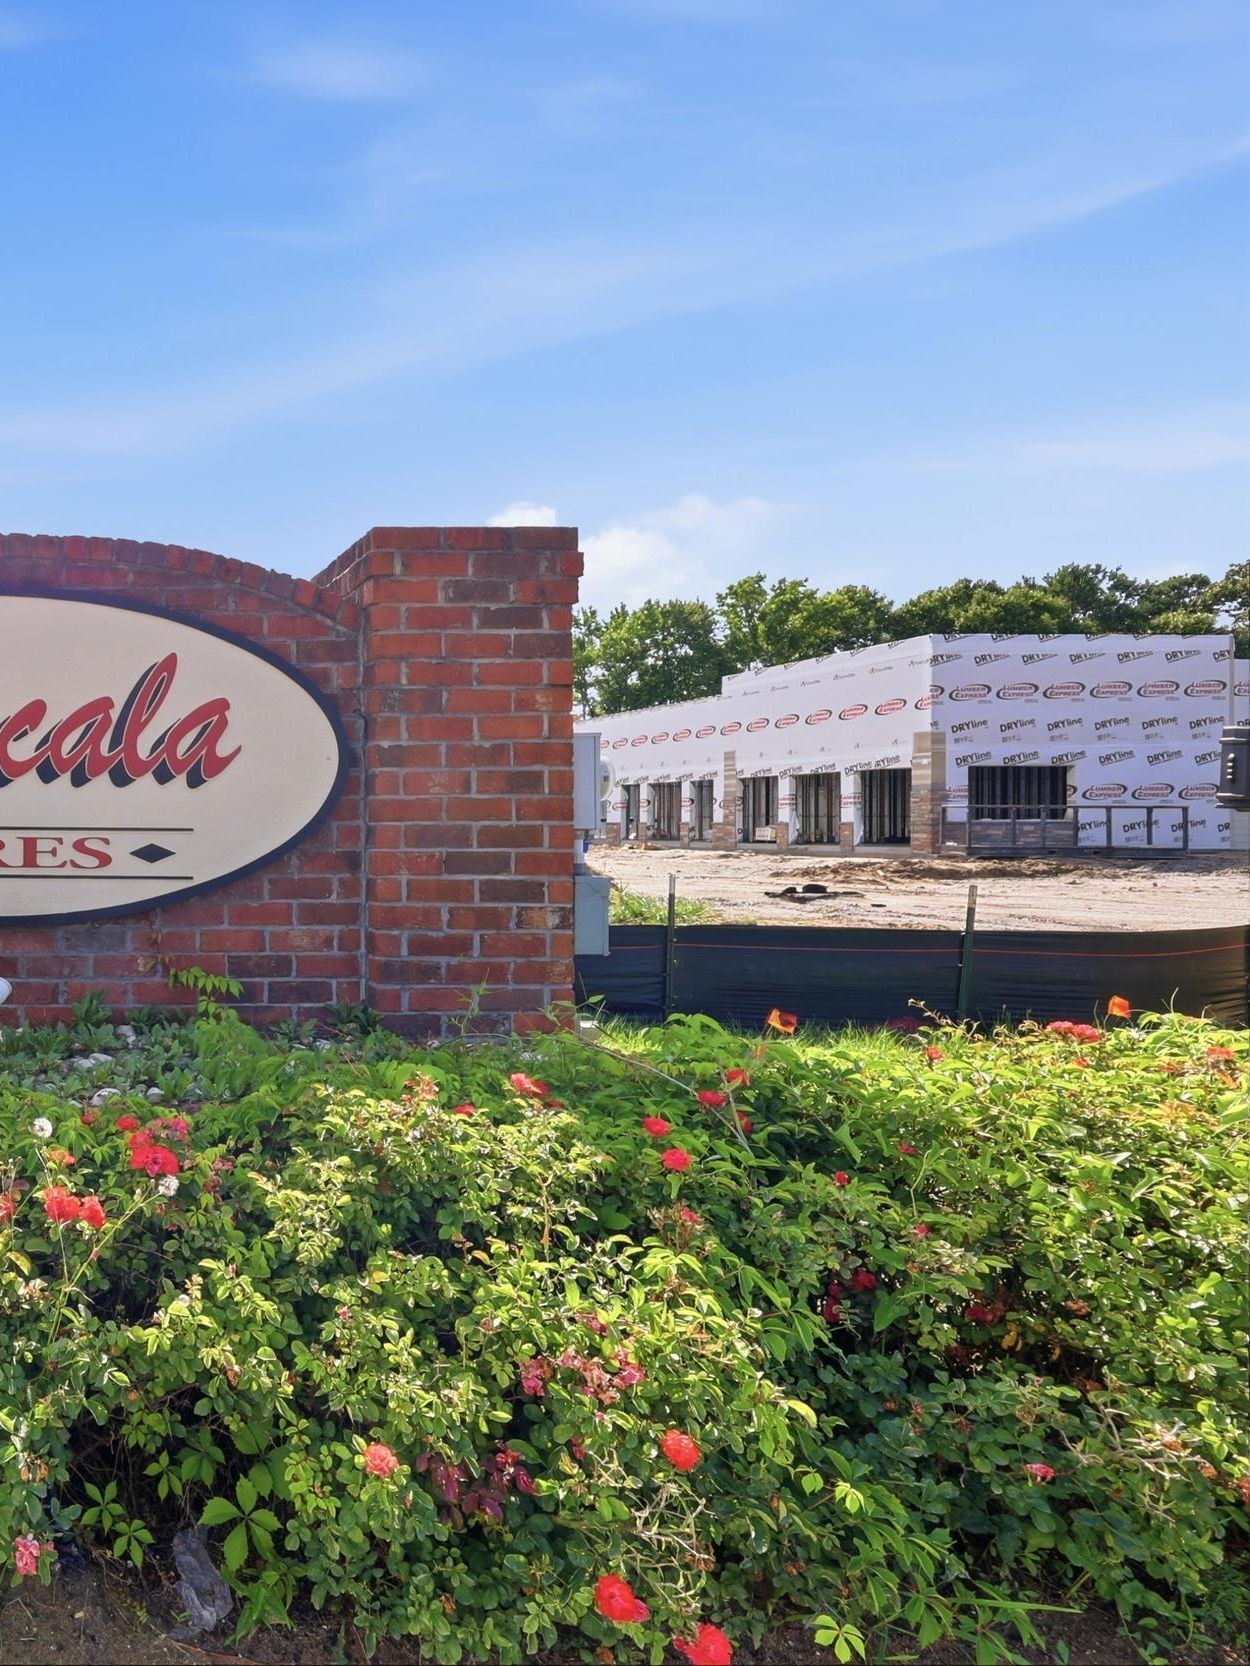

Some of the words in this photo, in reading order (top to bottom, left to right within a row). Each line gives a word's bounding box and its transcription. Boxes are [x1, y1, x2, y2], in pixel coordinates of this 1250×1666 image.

[951, 719, 989, 734] DRYline
[1000, 718, 1036, 733] DRYline
[1047, 717, 1083, 732] DRYline
[1094, 716, 1130, 731] DRYline
[1142, 716, 1178, 730] DRYline
[1189, 715, 1225, 730] DRYline
[955, 751, 992, 766] DRYline
[1003, 750, 1039, 765] DRYline
[1051, 750, 1087, 765] DRYline
[1099, 750, 1135, 764] DRYline
[1147, 750, 1183, 764] DRYline
